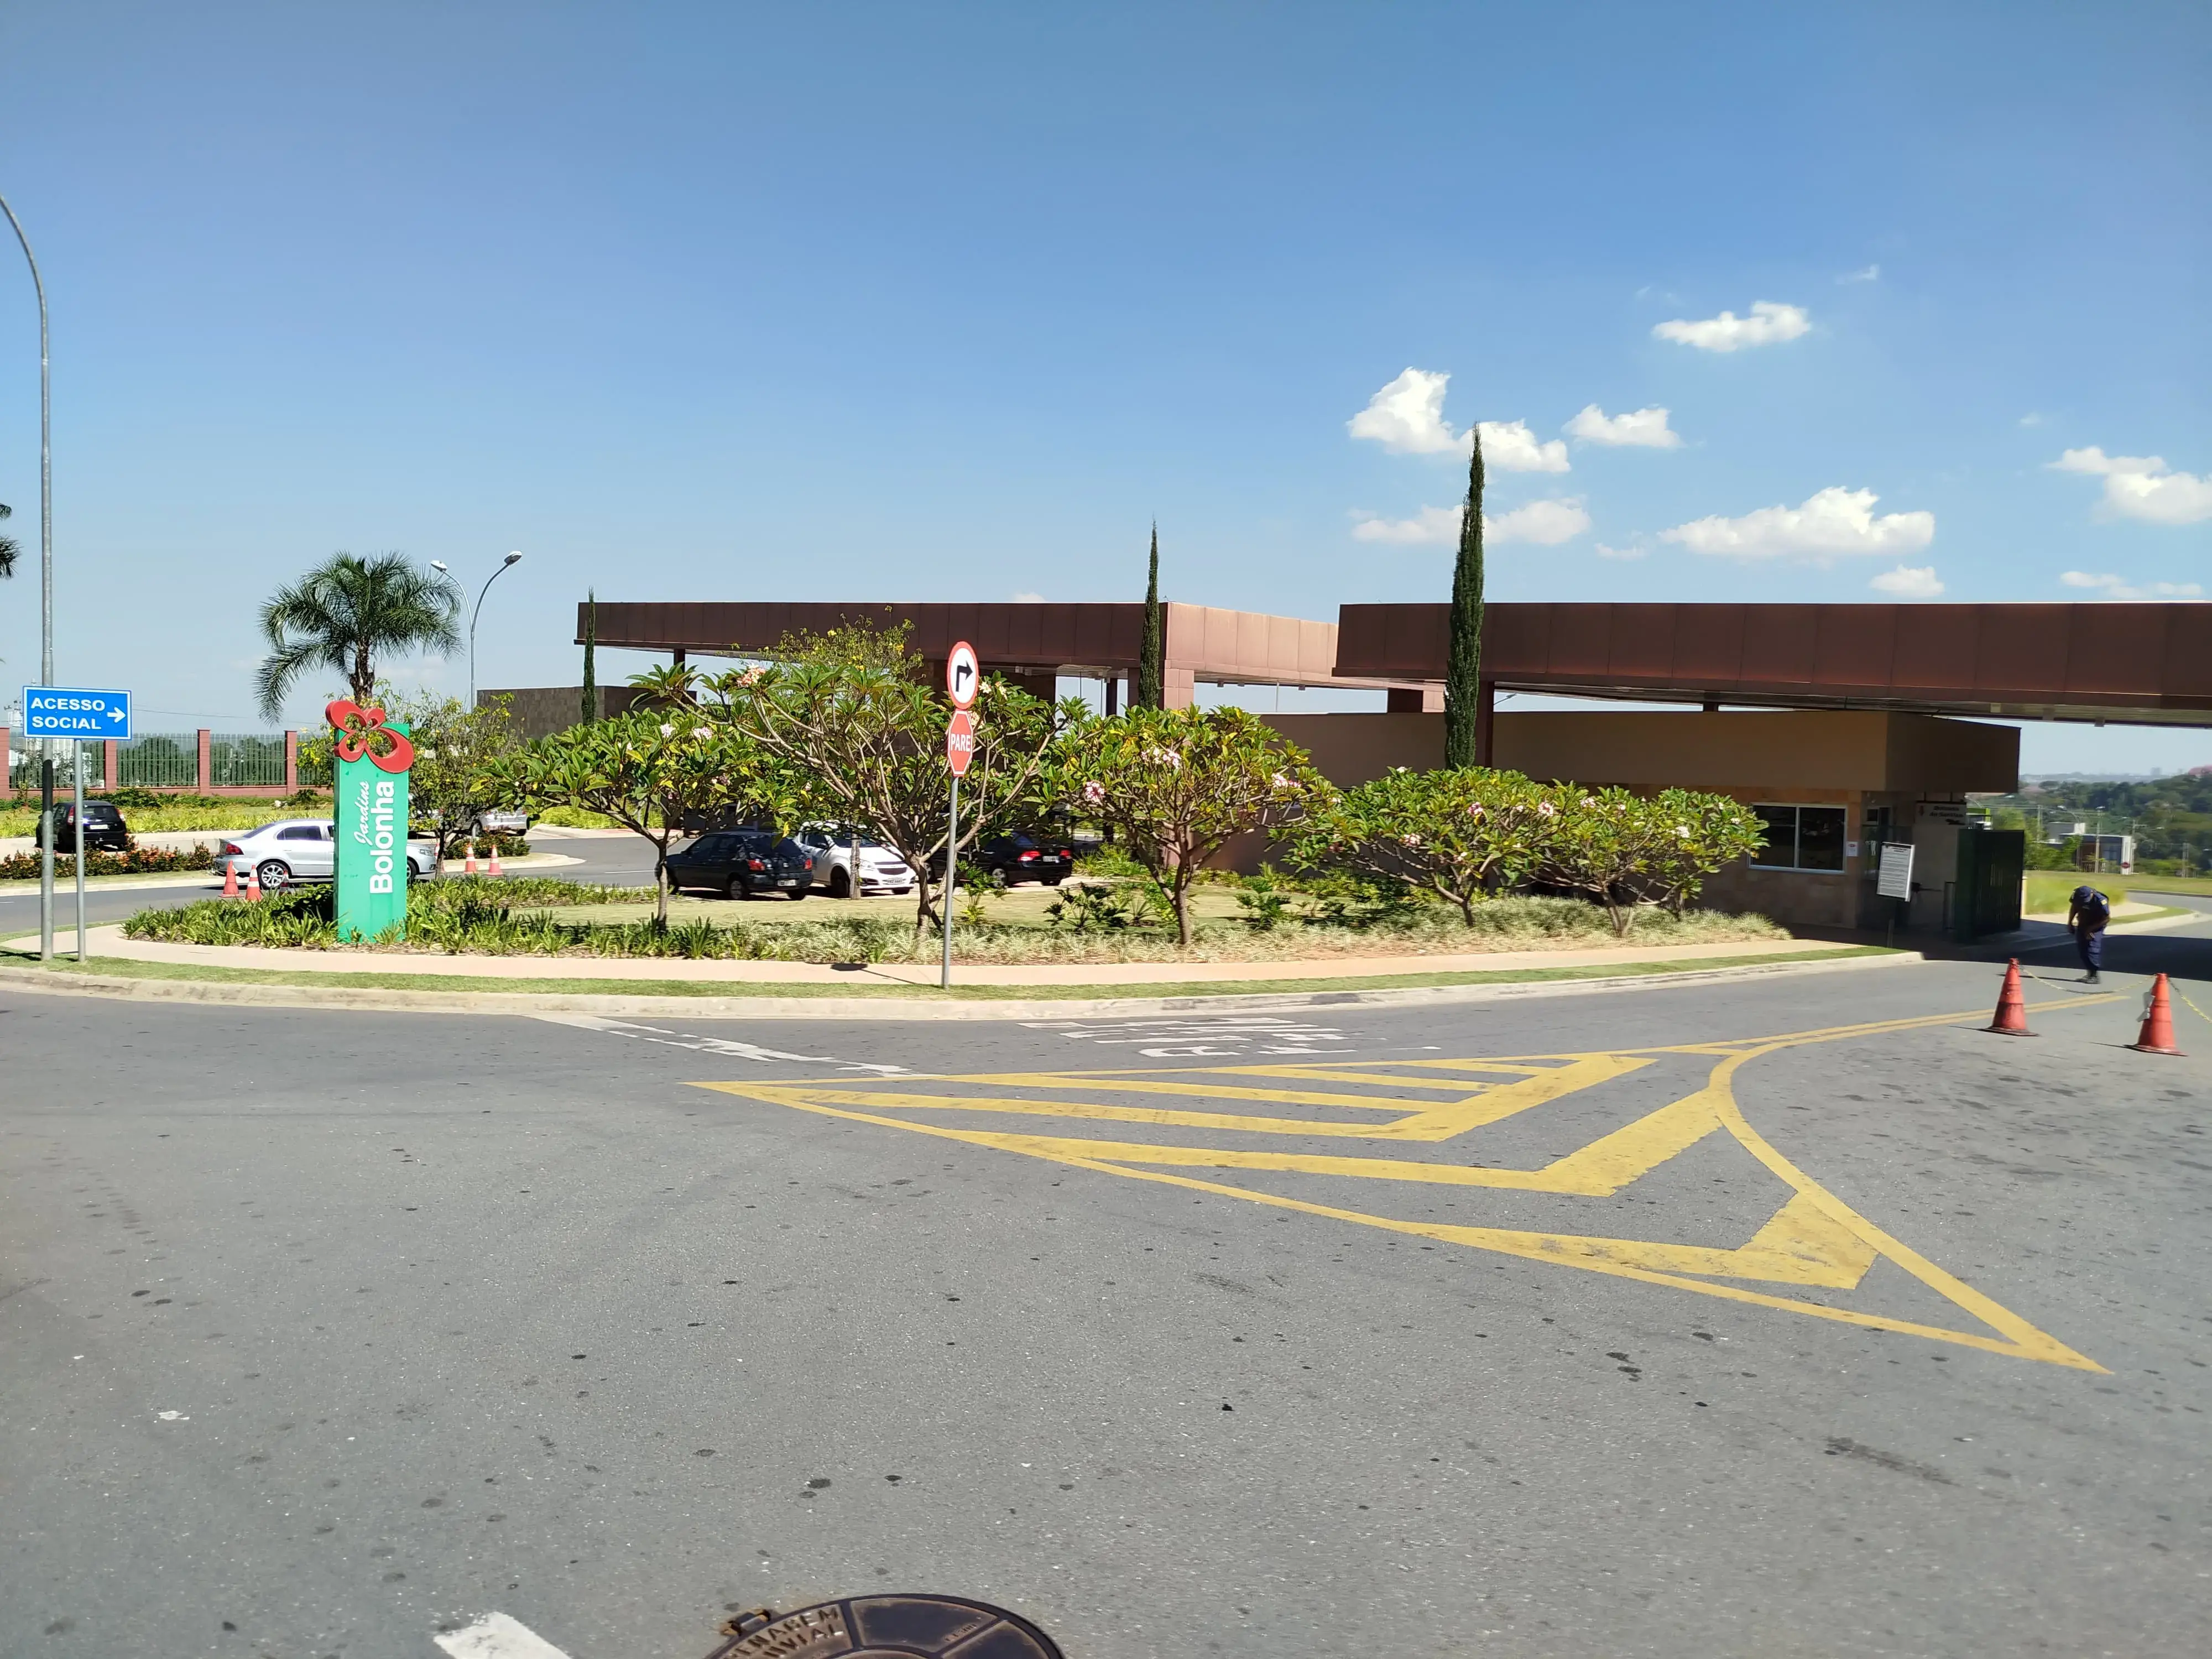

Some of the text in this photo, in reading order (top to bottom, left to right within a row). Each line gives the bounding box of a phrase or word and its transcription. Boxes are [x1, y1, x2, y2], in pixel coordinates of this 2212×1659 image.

[31, 697, 105, 711] ACESSO
[32, 716, 102, 729] SOCIAL
[951, 733, 971, 752] PARE
[353, 780, 373, 846] Jardins
[369, 780, 395, 894] Bolonha
[763, 1624, 844, 1658] UVIAL
